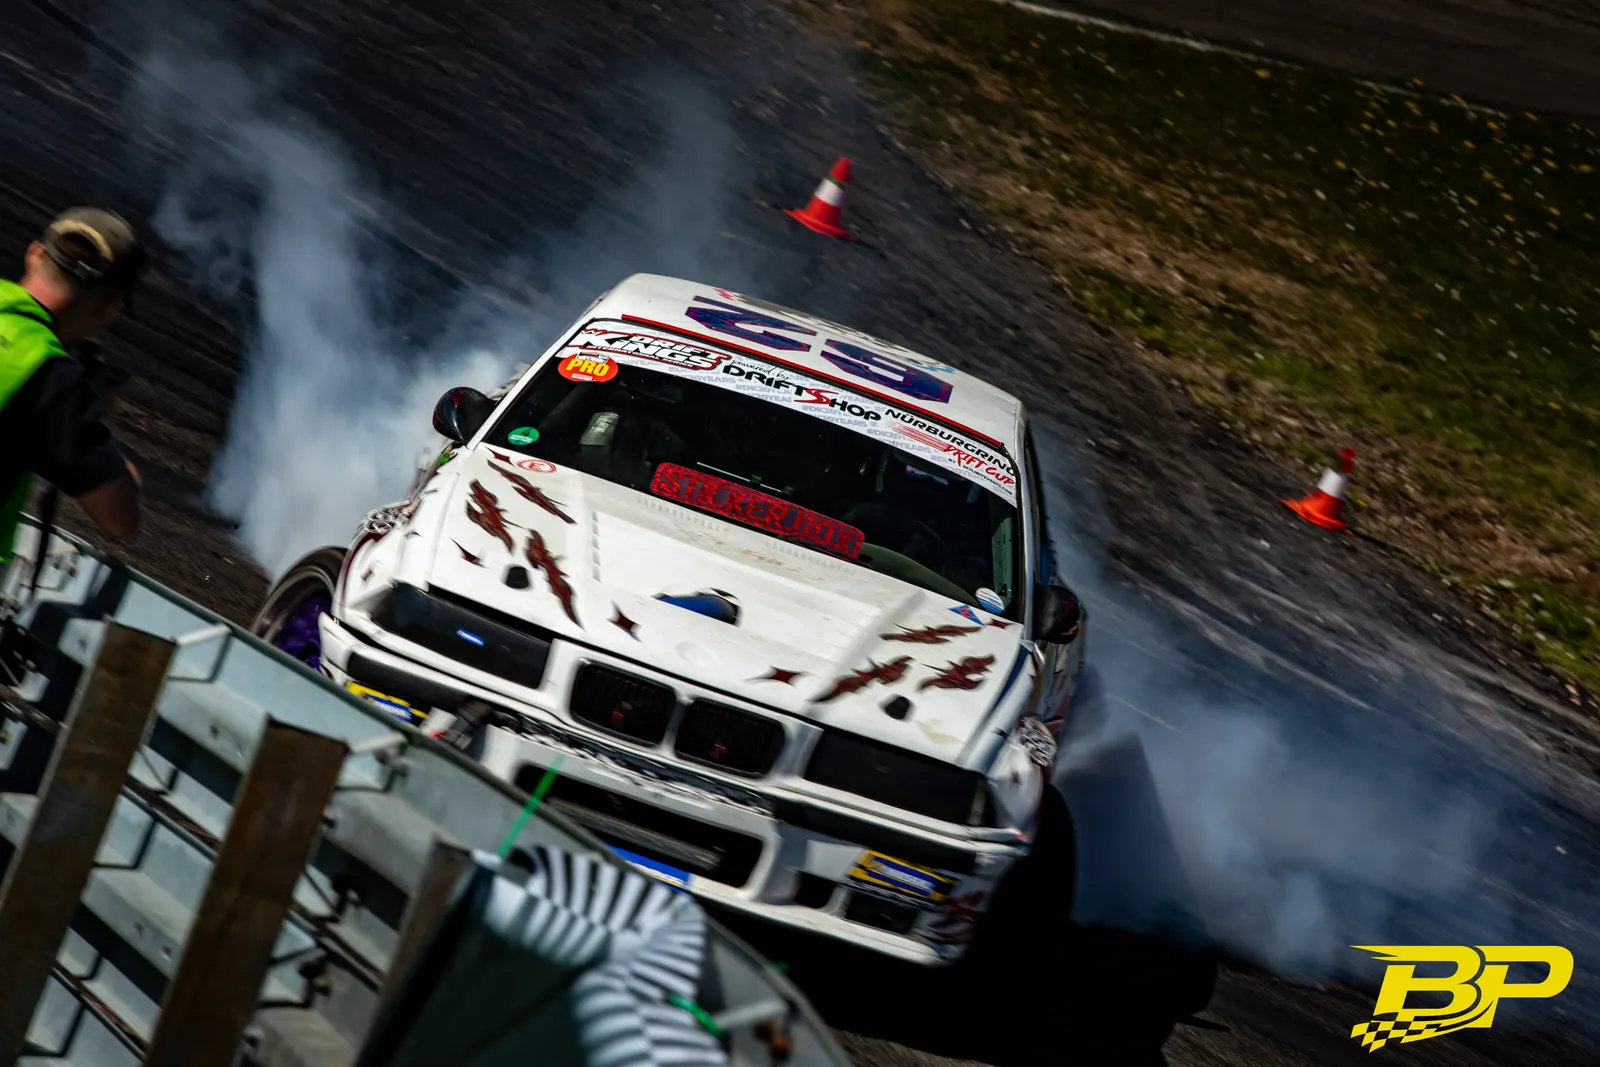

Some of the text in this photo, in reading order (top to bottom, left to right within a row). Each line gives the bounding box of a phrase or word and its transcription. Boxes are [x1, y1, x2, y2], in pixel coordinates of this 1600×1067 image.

[565, 358, 609, 377] PRO
[568, 332, 717, 370] KINGS
[630, 335, 731, 360] DRIFT
[722, 364, 881, 420] DRIFTSHOP
[943, 443, 988, 468] DRIFT
[985, 466, 1015, 485] CUP
[660, 468, 855, 554] STICKER BOX
